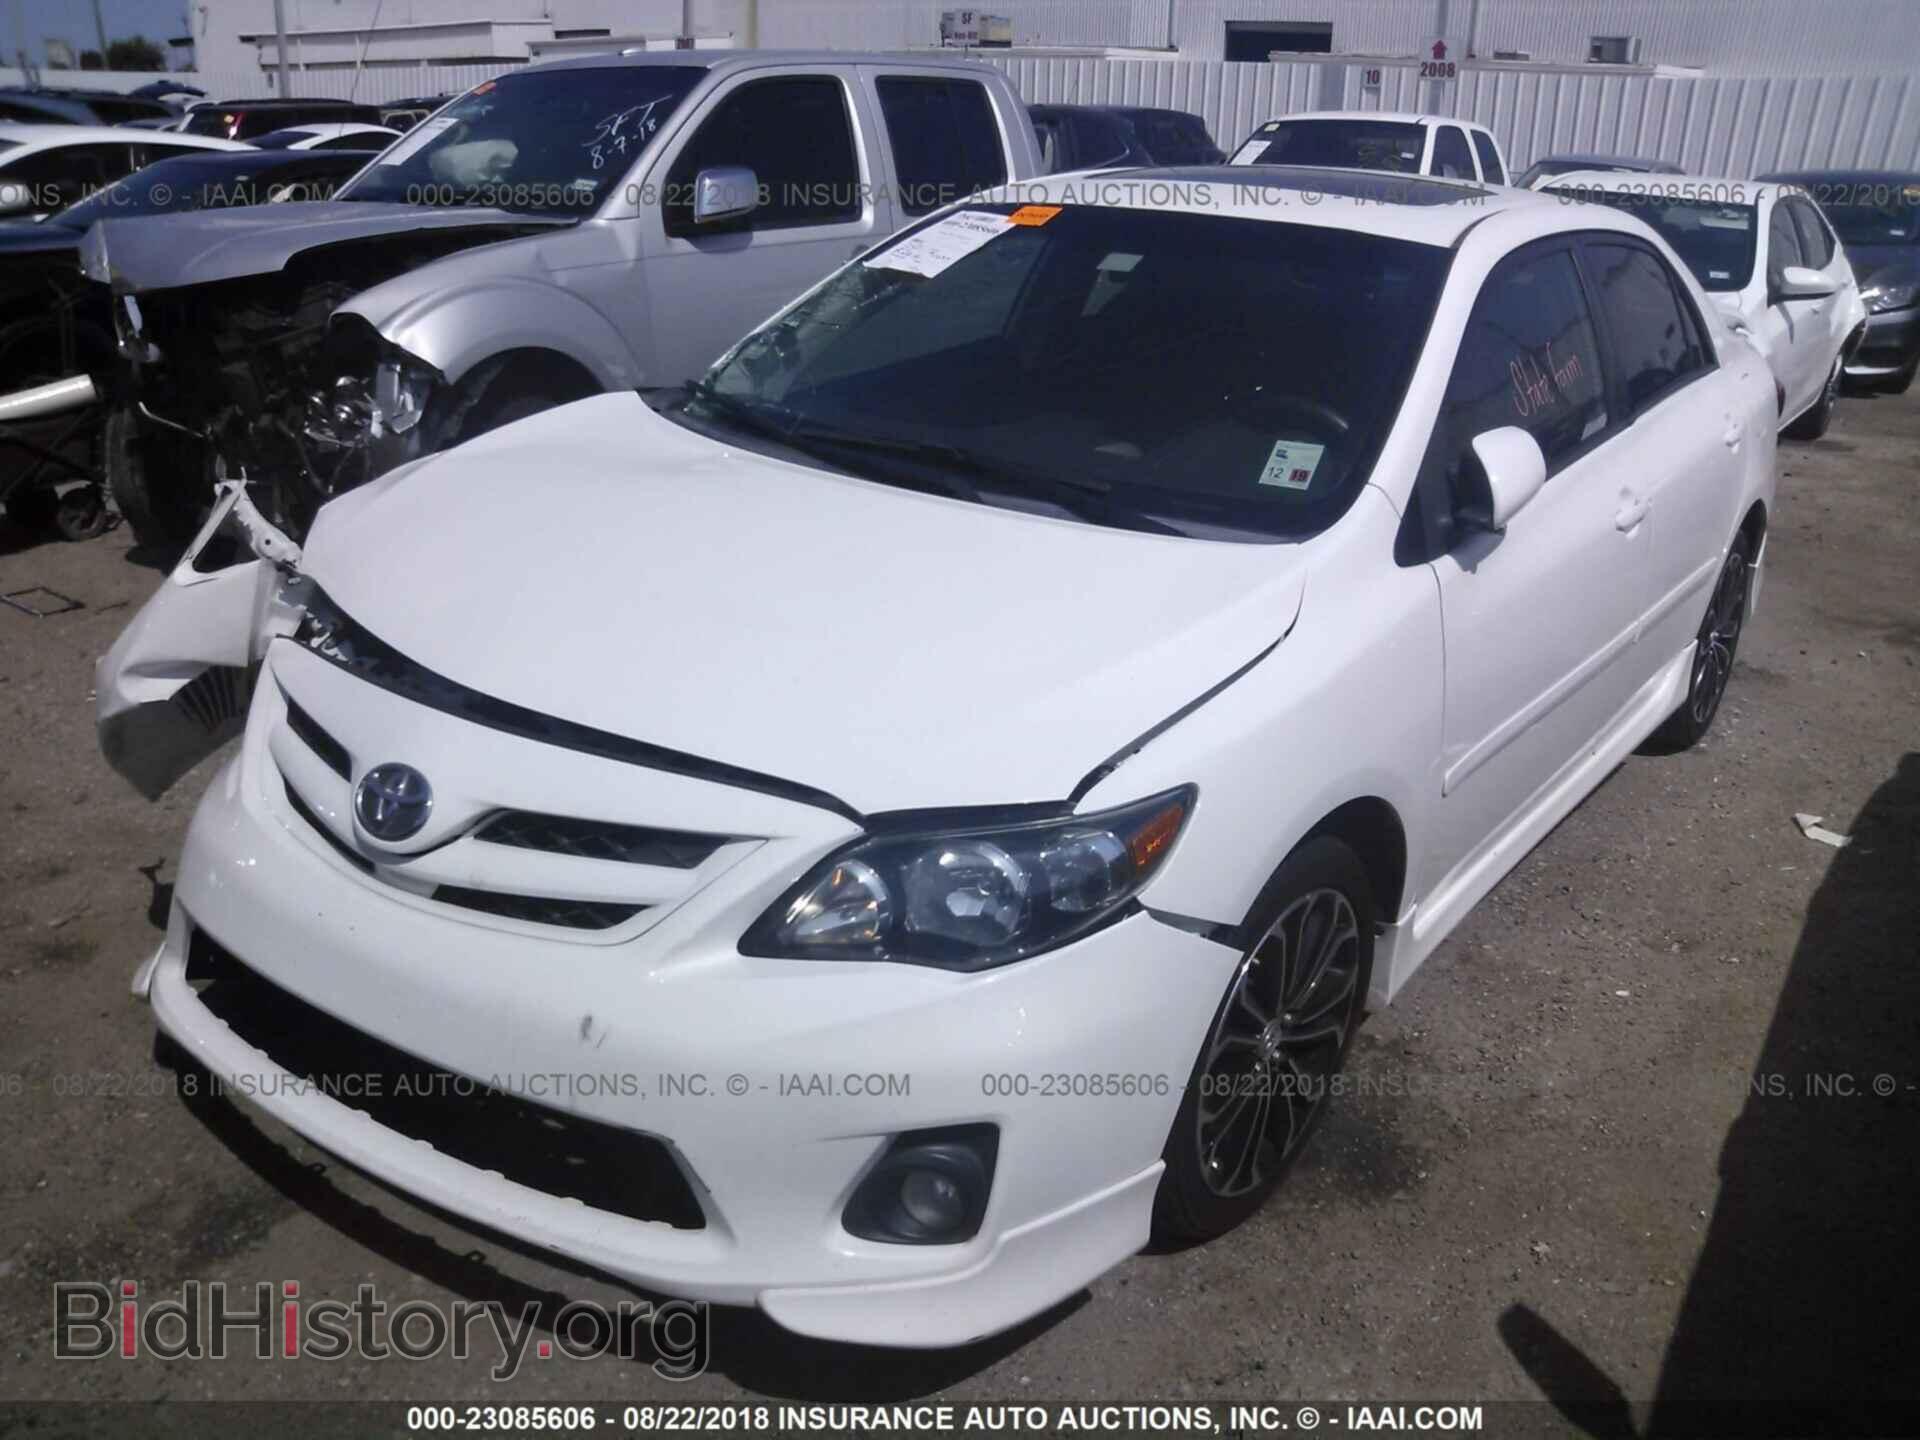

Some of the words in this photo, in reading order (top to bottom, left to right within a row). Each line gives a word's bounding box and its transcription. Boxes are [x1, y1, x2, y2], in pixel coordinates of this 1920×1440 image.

[1366, 69, 1380, 85] 10
[1420, 61, 1456, 78] 2008
[1268, 466, 1285, 479] 12
